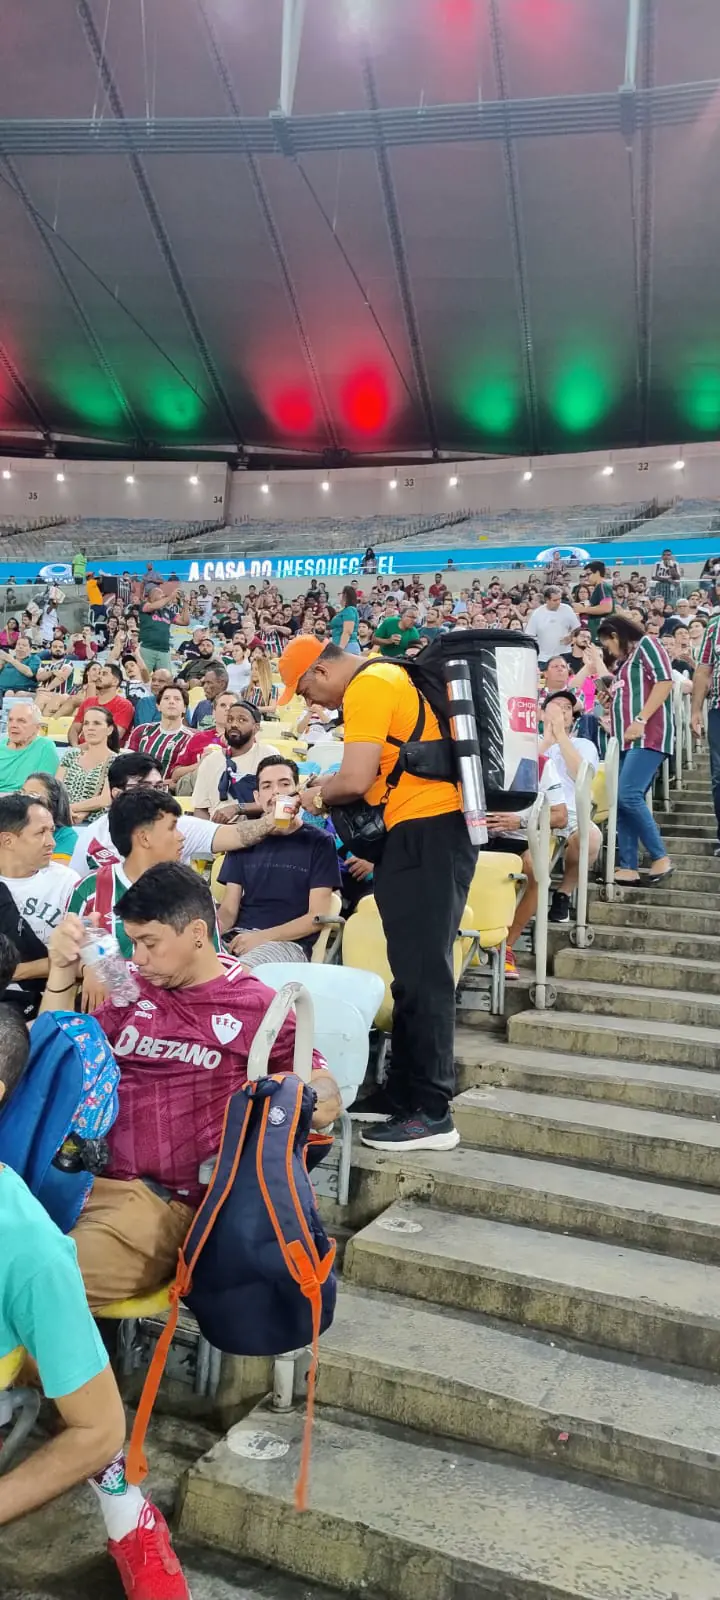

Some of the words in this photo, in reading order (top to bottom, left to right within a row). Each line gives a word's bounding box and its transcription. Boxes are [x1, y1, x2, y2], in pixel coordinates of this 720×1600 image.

[638, 462, 648, 471] 32
[404, 478, 414, 487] 33
[28, 491, 38, 501] 35
[213, 495, 223, 504] 34
[188, 562, 200, 581] A
[203, 560, 246, 580] CASA
[250, 560, 272, 577] DO
[275, 554, 397, 578] INESQUECEL
[135, 1035, 222, 1070] BETANO
